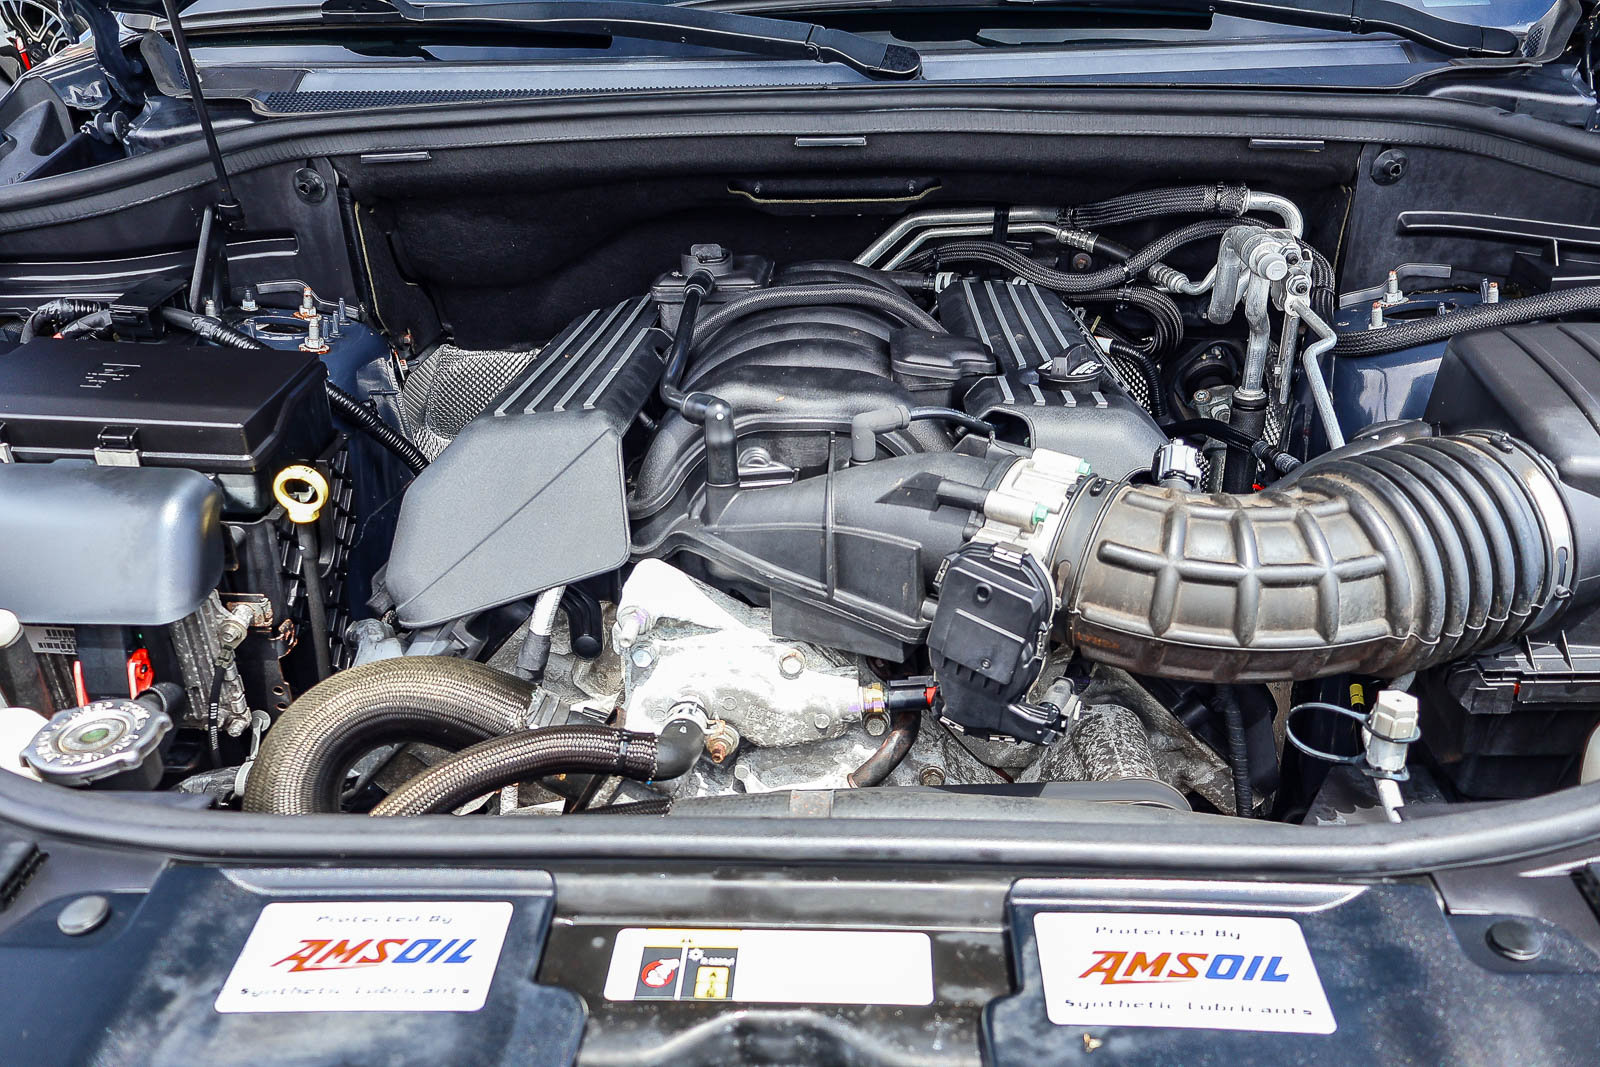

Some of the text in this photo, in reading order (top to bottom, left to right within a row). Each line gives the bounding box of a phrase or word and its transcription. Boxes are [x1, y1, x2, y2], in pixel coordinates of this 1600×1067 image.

[1215, 929, 1241, 941] By
[270, 938, 477, 973] AMSOIL
[1078, 950, 1290, 985] AMSOIL
